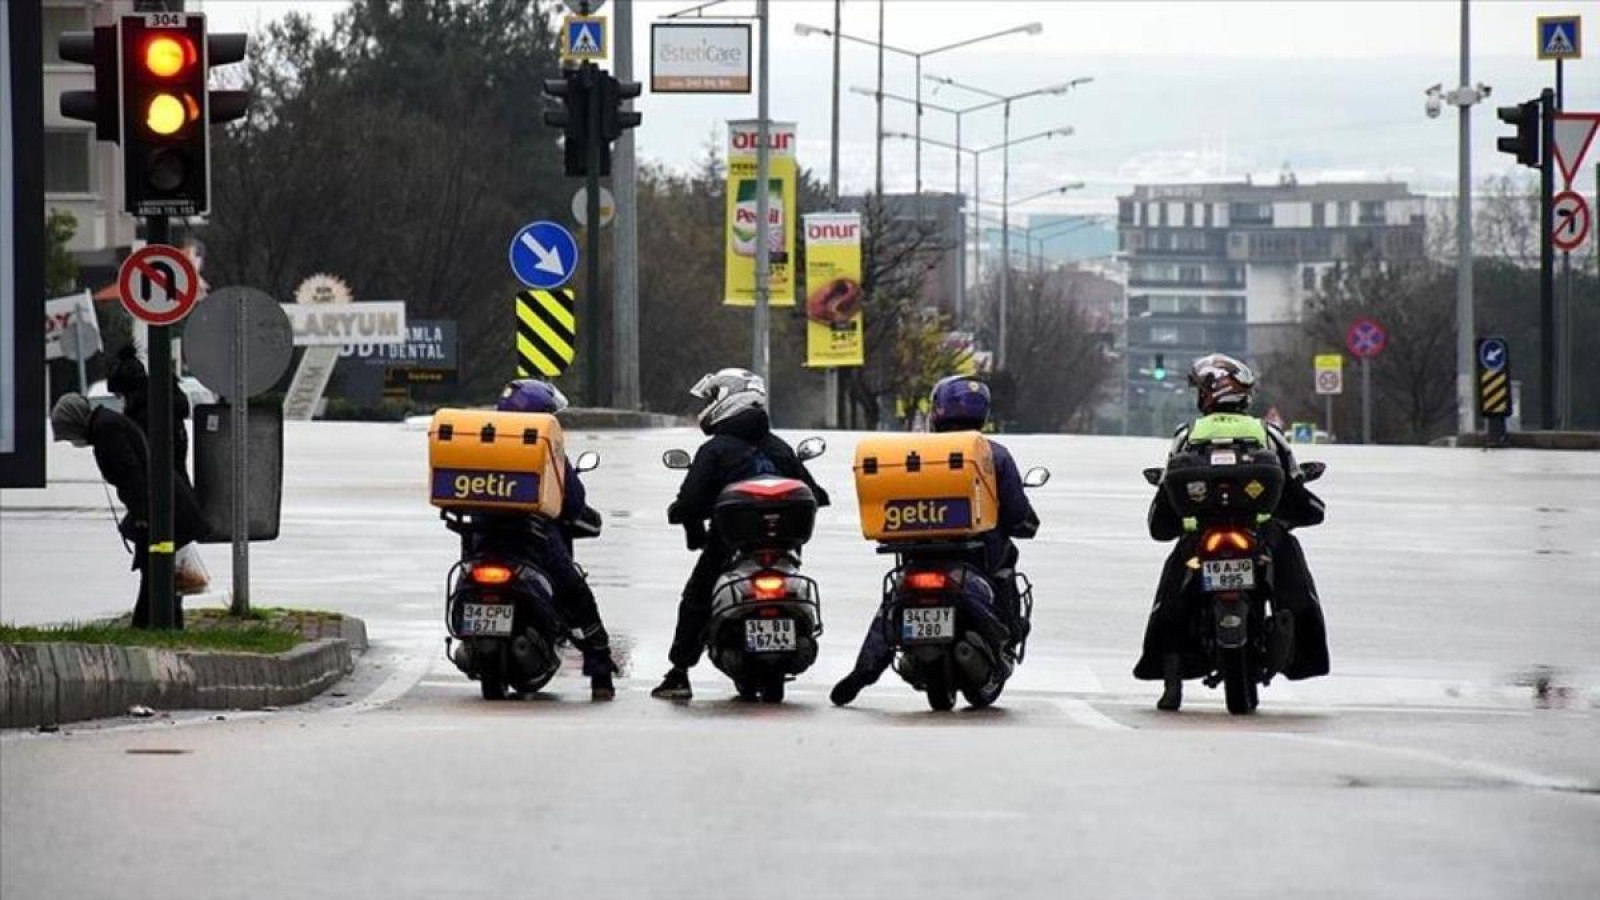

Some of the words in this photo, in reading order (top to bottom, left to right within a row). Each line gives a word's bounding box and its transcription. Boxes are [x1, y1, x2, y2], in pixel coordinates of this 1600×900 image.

[152, 14, 178, 26] 304
[736, 207, 779, 225] Peil
[808, 223, 858, 240] onur
[454, 473, 518, 499] getir
[885, 501, 948, 530] getir
[464, 605, 482, 618] 34
[486, 606, 512, 619] CPU
[905, 609, 921, 622] 34
[474, 619, 497, 631] 671
[748, 620, 764, 633] 34
[917, 622, 941, 636] 280
[756, 634, 790, 647] 6744
